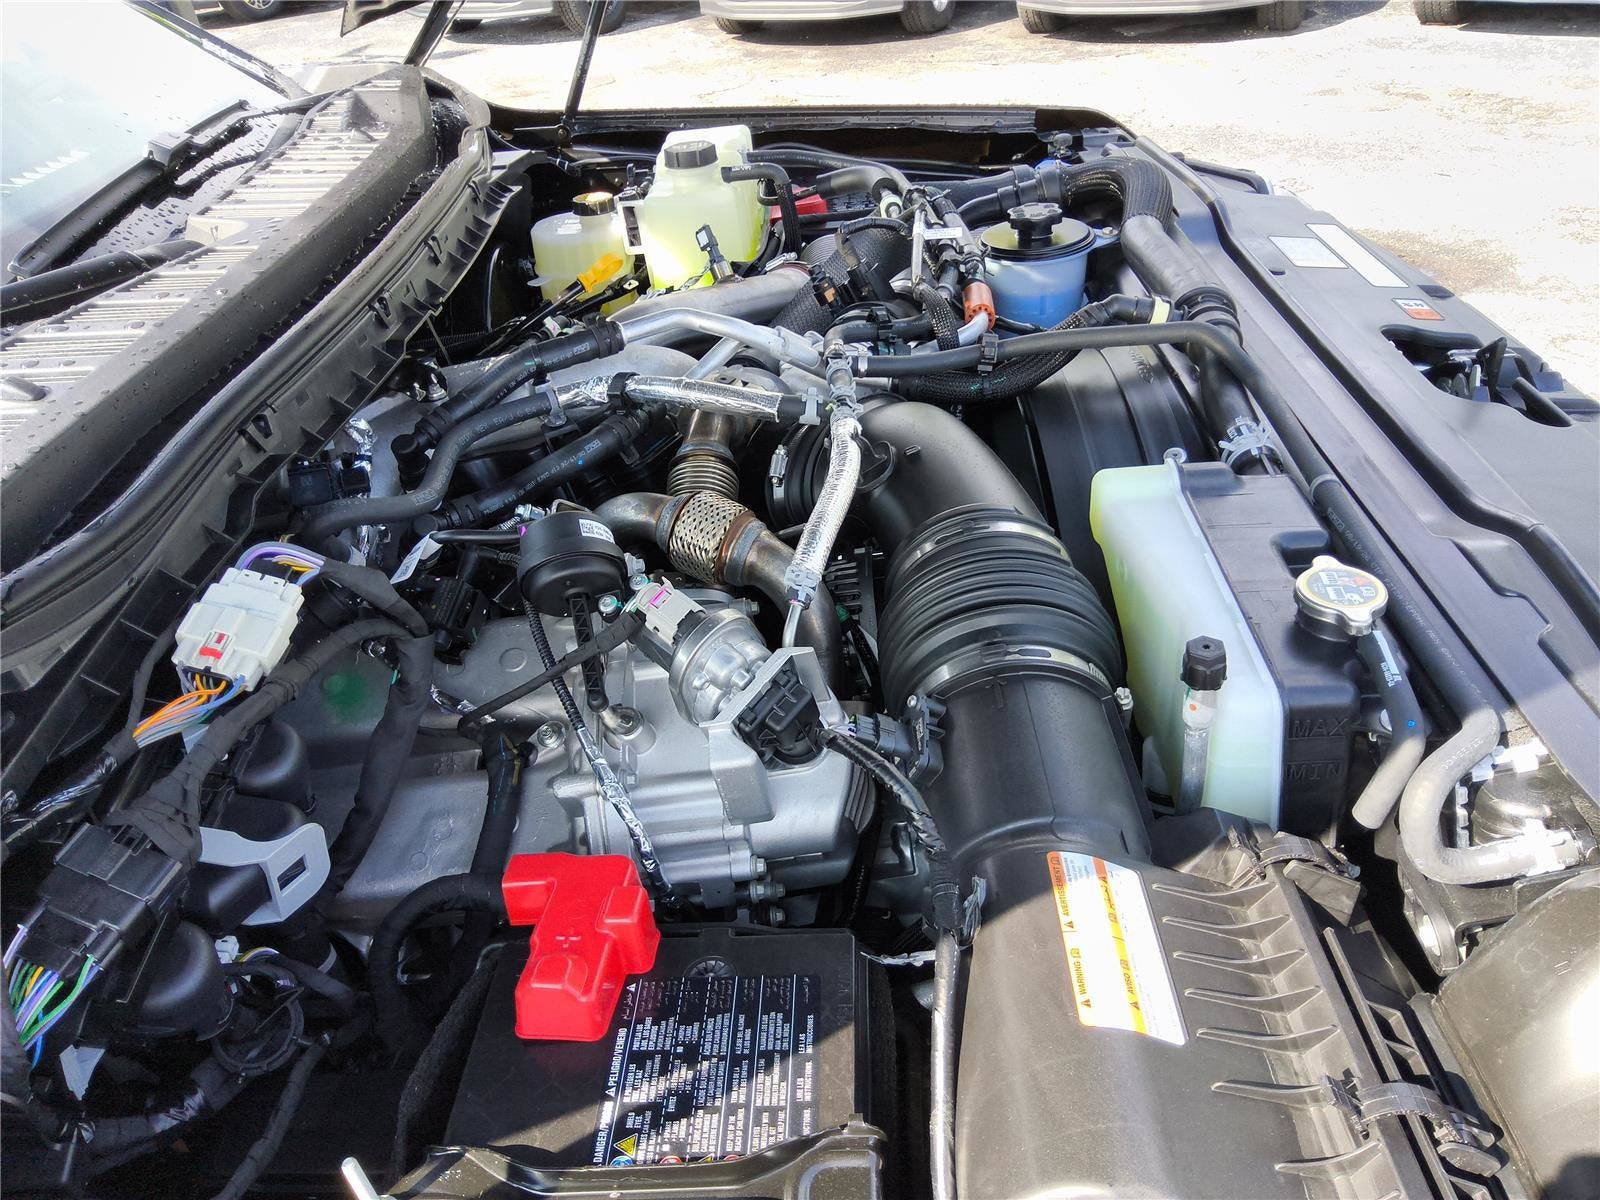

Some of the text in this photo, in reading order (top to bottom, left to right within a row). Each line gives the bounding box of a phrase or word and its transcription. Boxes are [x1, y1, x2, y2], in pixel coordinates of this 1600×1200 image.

[1292, 718, 1349, 737] MAX
[1288, 762, 1342, 780] MIN
[1053, 866, 1069, 917] AVERTISSEMENT
[1074, 960, 1088, 995] WARNING
[1123, 971, 1136, 996] AVISO
[798, 1033, 806, 1054] LEA LAS
[608, 1028, 627, 1086] PELIGRO/VENENO
